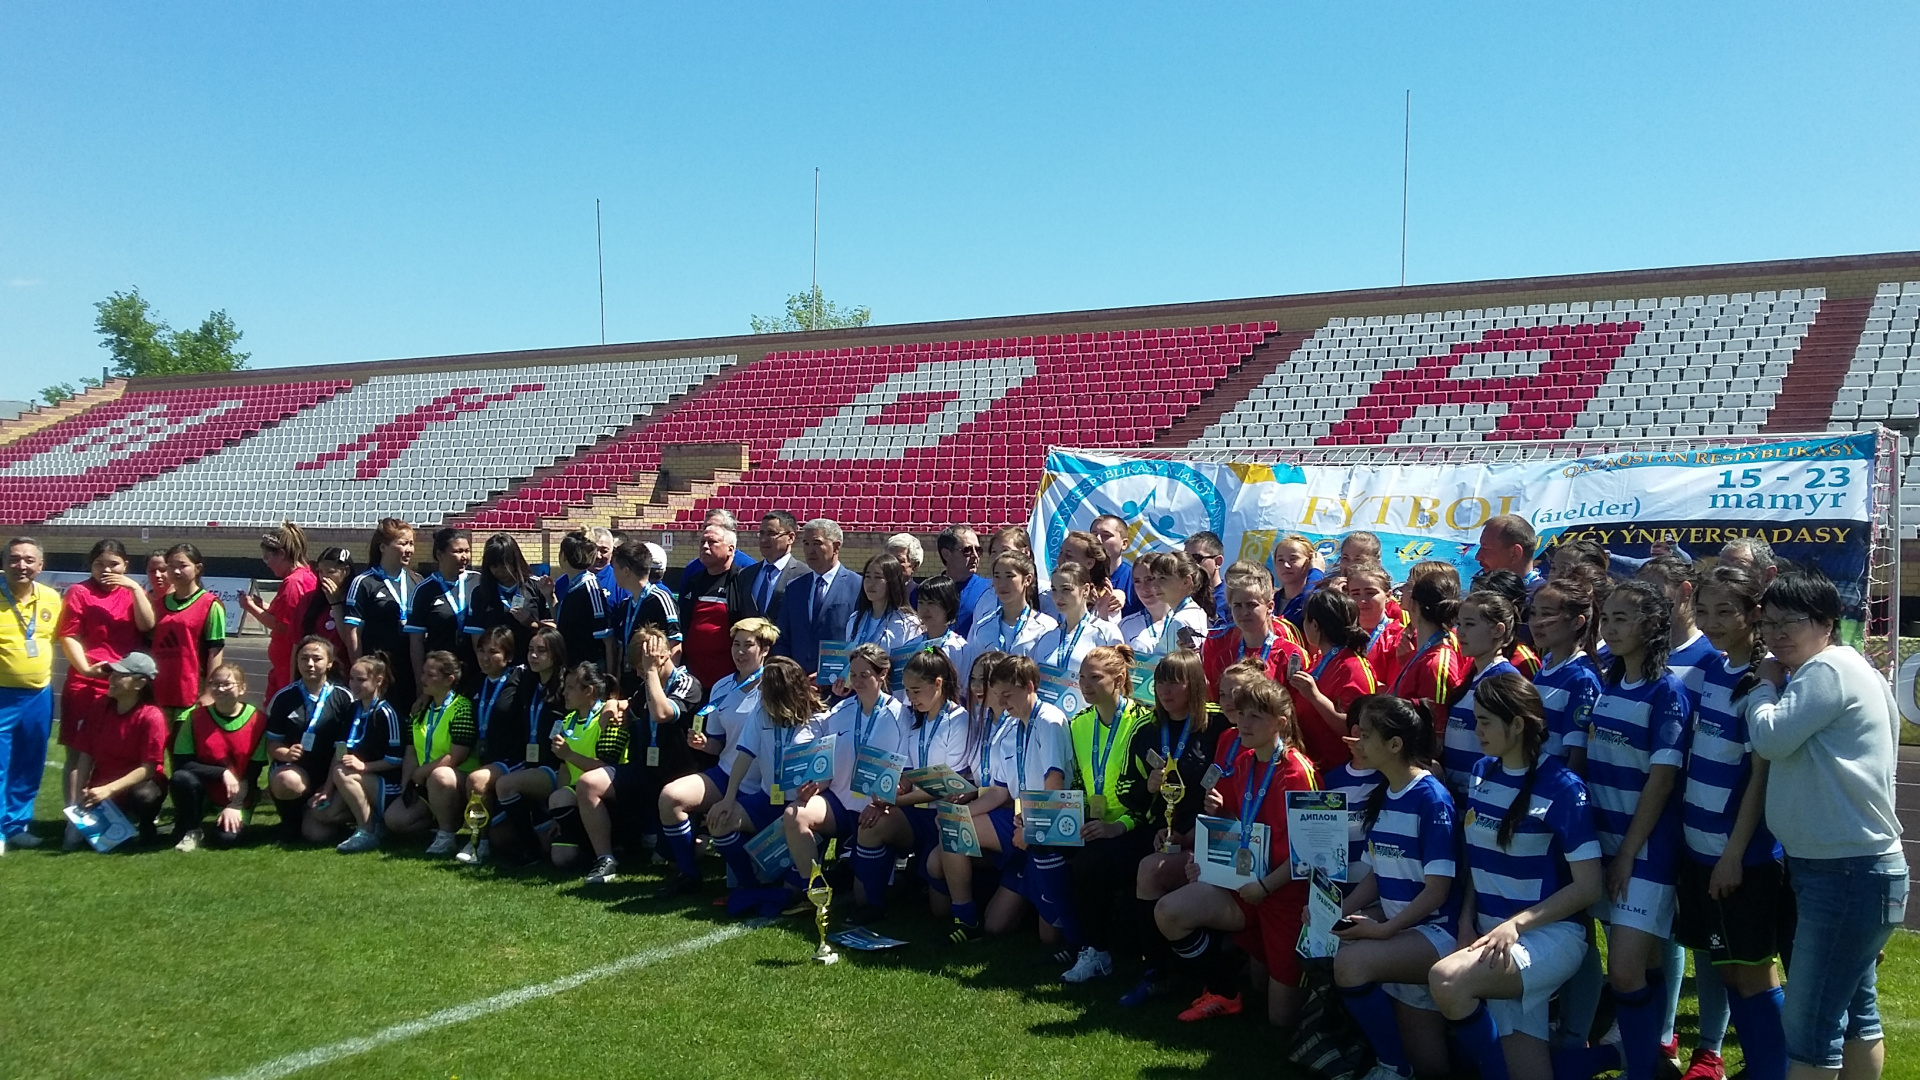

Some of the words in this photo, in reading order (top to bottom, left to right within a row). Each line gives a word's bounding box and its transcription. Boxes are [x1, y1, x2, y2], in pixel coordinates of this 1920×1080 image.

[1717, 467, 1762, 489] 15
[1804, 466, 1851, 489] 23
[1708, 491, 1847, 517] mamyr
[664, 533, 671, 544] 11
[1300, 813, 1338, 822] ДИПЛОМ
